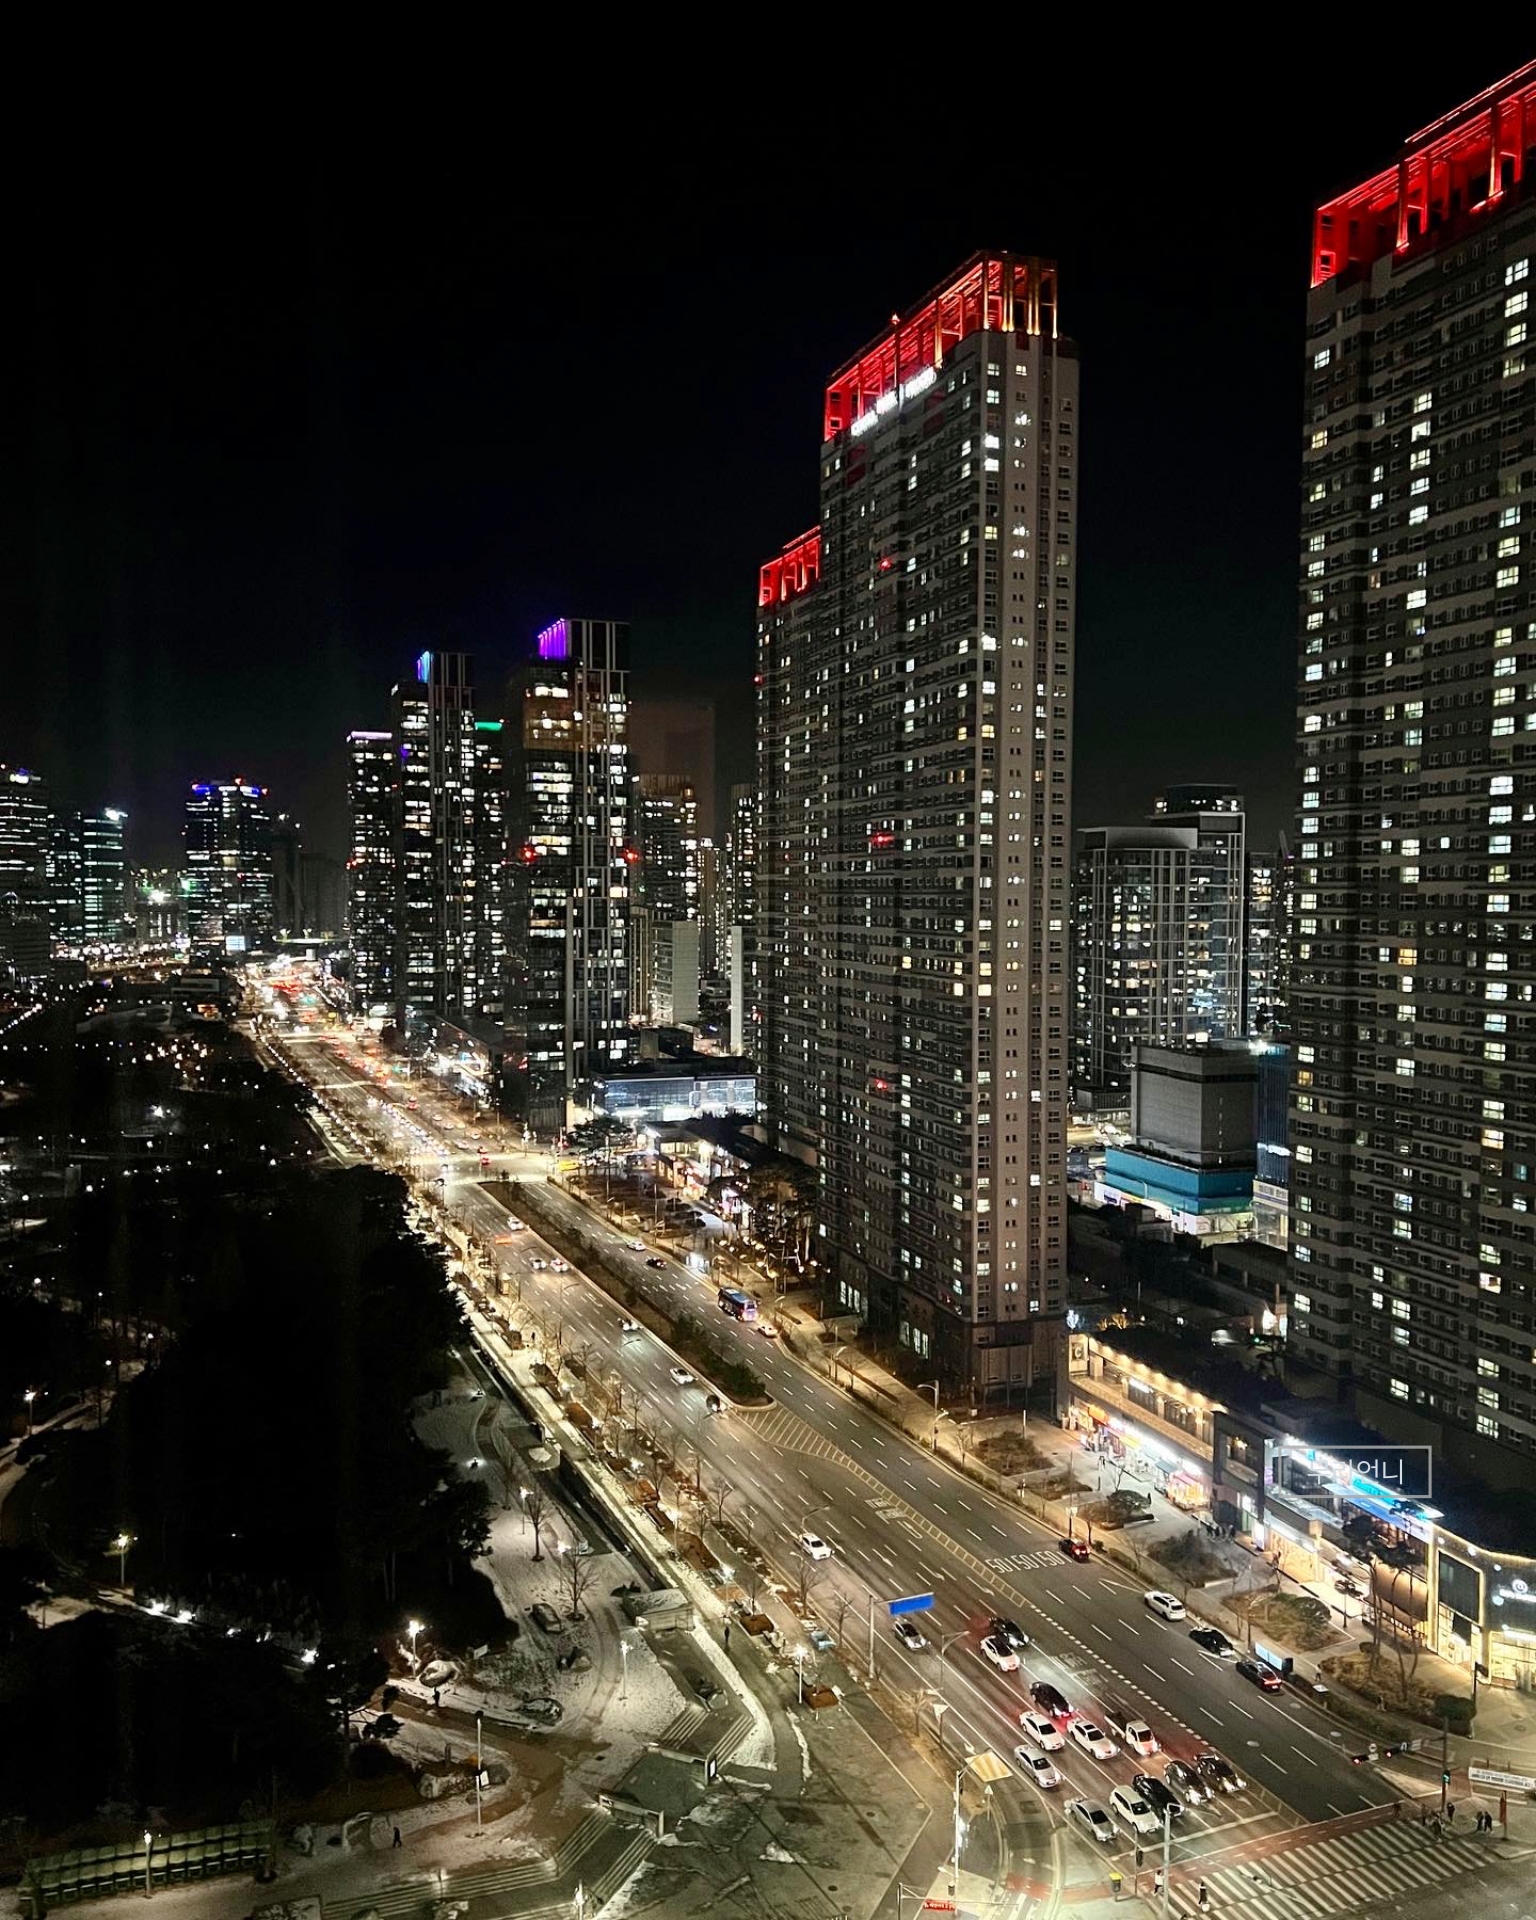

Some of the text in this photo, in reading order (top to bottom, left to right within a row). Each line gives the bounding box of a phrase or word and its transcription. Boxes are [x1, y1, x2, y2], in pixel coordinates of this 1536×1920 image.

[985, 1550, 1066, 1574] 50 50 50
